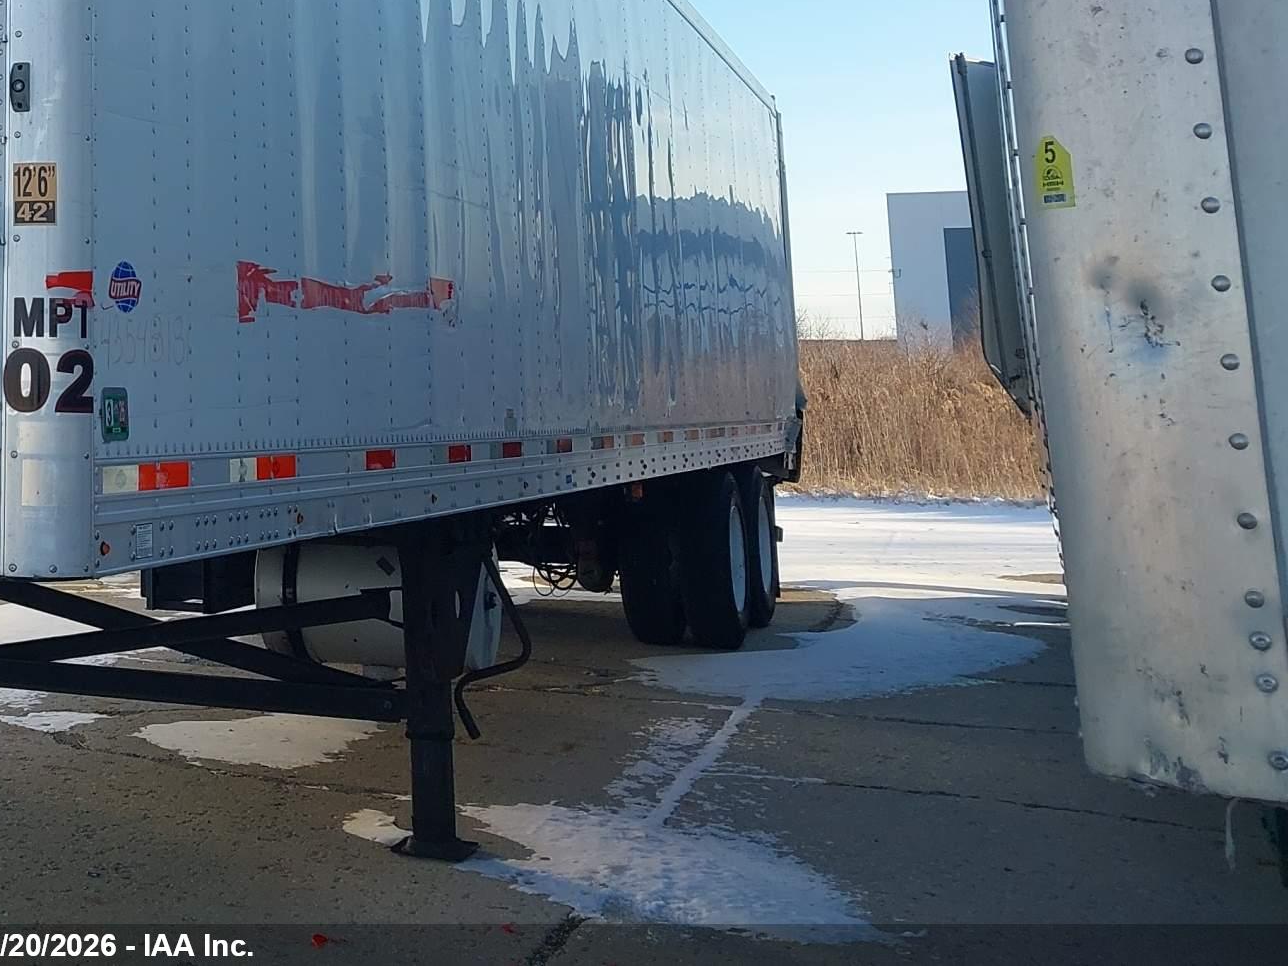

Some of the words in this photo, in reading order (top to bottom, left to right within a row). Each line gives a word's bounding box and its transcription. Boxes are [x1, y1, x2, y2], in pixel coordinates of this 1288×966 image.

[1044, 141, 1056, 164] 5
[111, 280, 140, 297] UTILITY
[3, 347, 95, 413] 02
